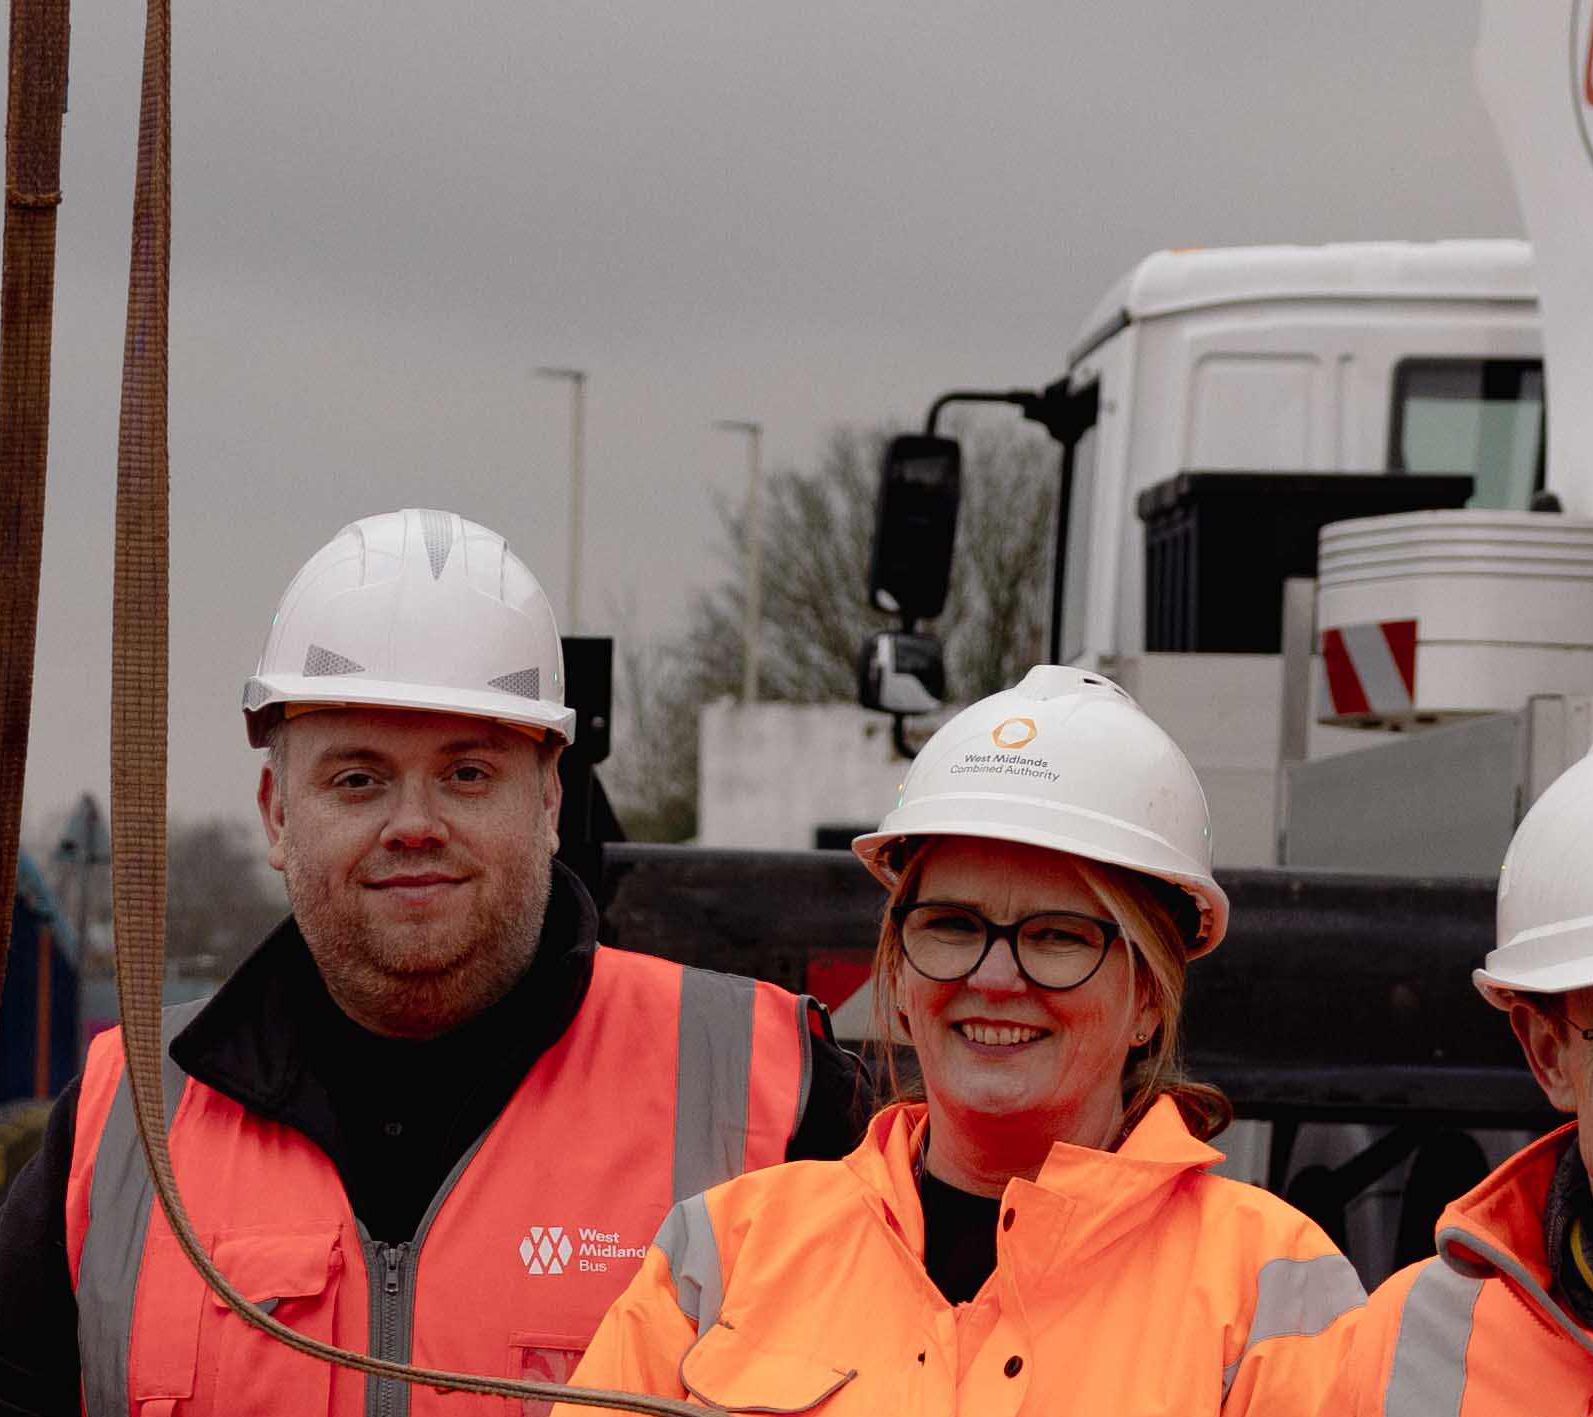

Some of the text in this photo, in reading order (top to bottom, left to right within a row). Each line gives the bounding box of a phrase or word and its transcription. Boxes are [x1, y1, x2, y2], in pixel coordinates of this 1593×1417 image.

[964, 754, 1049, 768] West Midlands
[950, 764, 1060, 782] Combined Authority
[578, 1228, 620, 1244] West
[578, 1243, 647, 1259] Midland
[579, 1260, 608, 1273] Bus
